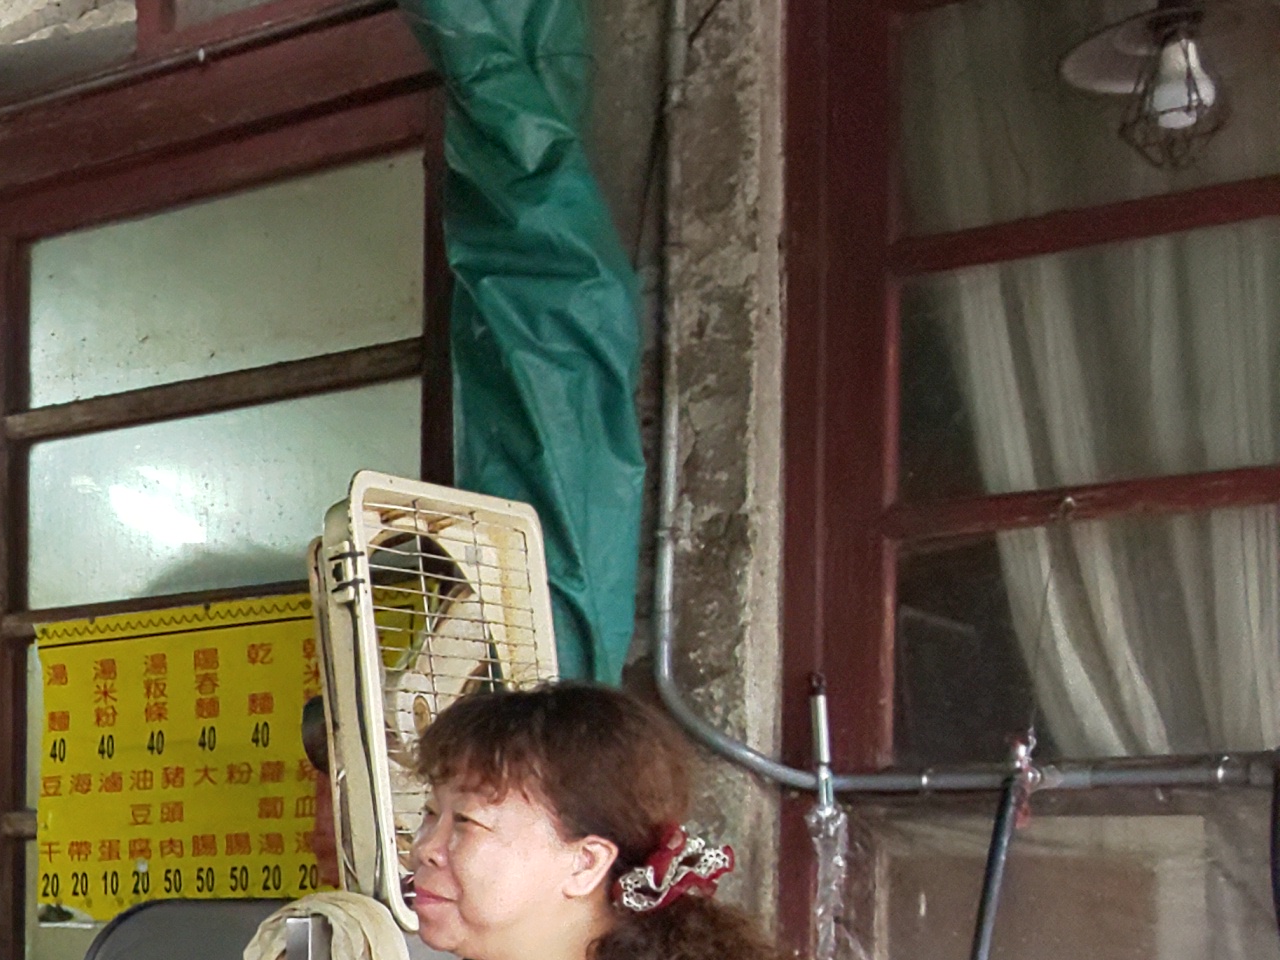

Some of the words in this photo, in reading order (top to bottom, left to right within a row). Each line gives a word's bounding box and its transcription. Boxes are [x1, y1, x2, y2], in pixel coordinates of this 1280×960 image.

[47, 663, 69, 732] 湯麵
[93, 658, 117, 727] 湯米粉
[143, 653, 168, 722] 湯粄條
[193, 648, 219, 718] 陽春麵
[49, 737, 66, 763] 40
[98, 734, 115, 759] 40
[147, 730, 165, 756] 40
[198, 726, 217, 752] 40
[251, 721, 270, 748] 40
[40, 775, 62, 863] 豆干
[68, 773, 92, 861] 海帶
[98, 771, 122, 862] 滷蛋
[128, 769, 153, 861] 油豆腐
[159, 766, 184, 858] 豬頭肉
[192, 765, 218, 857] 大腸
[225, 762, 252, 856] 粉腸
[41, 872, 60, 897] 20
[71, 872, 88, 896] 20
[102, 871, 119, 895] 10
[132, 870, 150, 895] 20
[163, 868, 182, 893] 50
[196, 867, 215, 892] 50
[229, 865, 249, 892] 50
[262, 865, 281, 890] 20
[298, 864, 319, 890] 20
